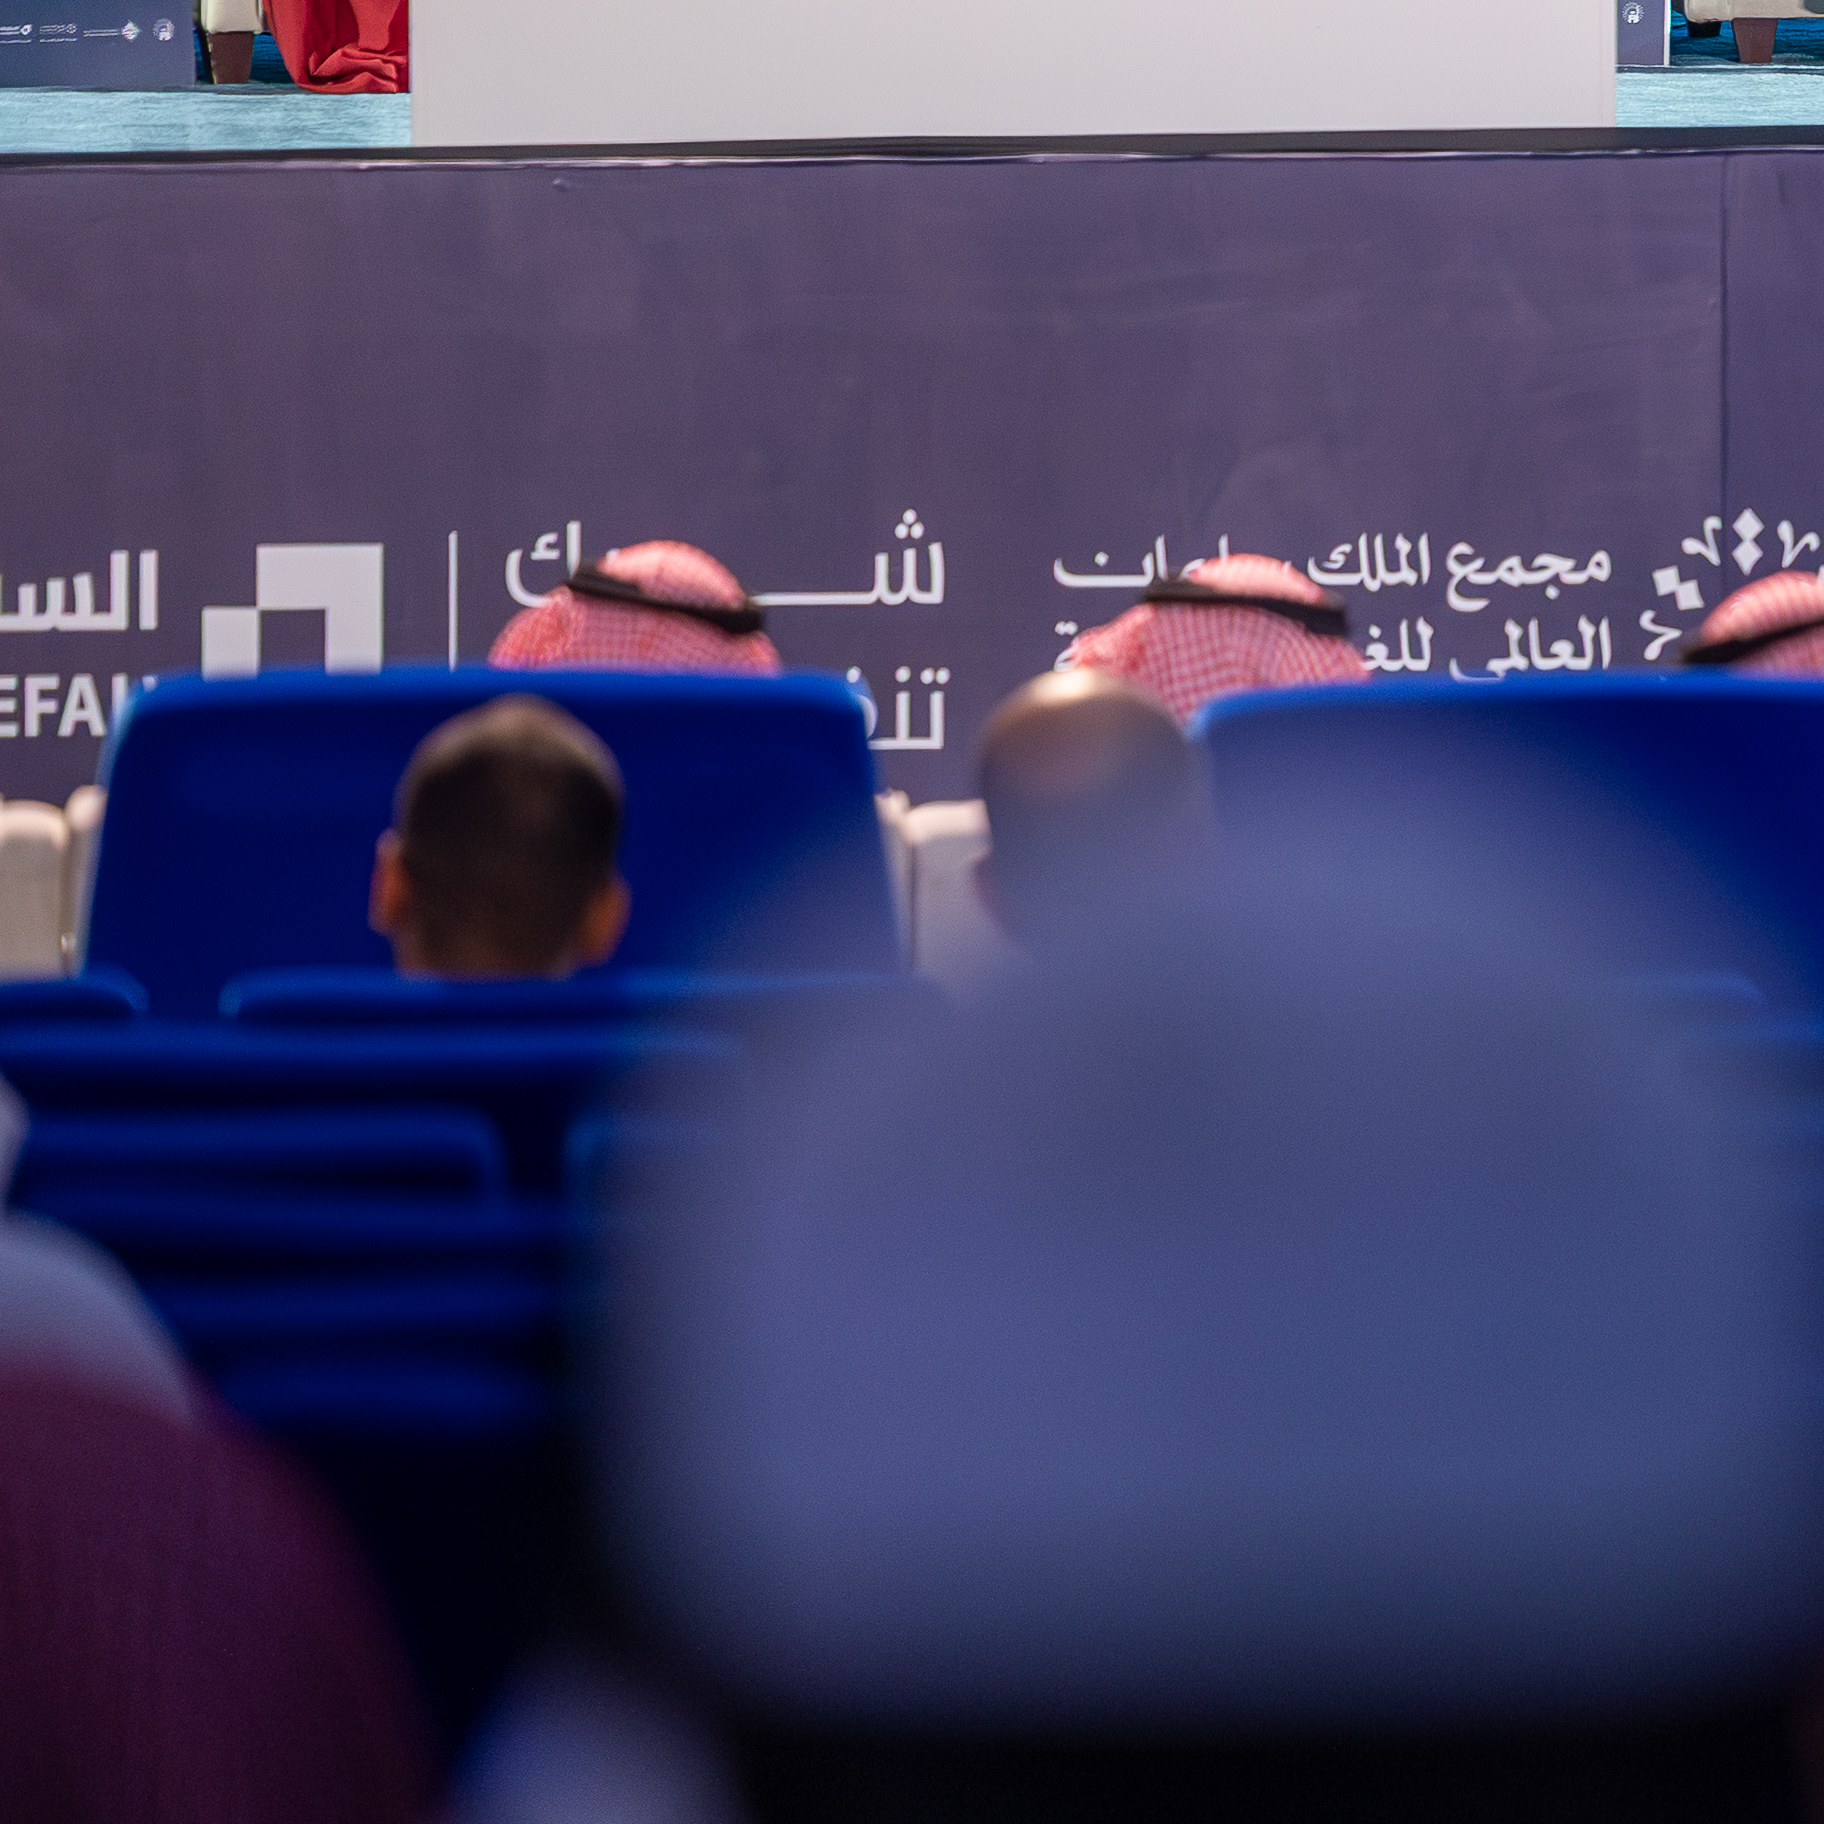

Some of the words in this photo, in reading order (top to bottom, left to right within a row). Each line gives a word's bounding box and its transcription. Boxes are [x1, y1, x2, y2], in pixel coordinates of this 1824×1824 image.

[1307, 532, 1431, 592] الملك
[1446, 541, 1612, 612] مجمع
[1362, 616, 1435, 672] للغ
